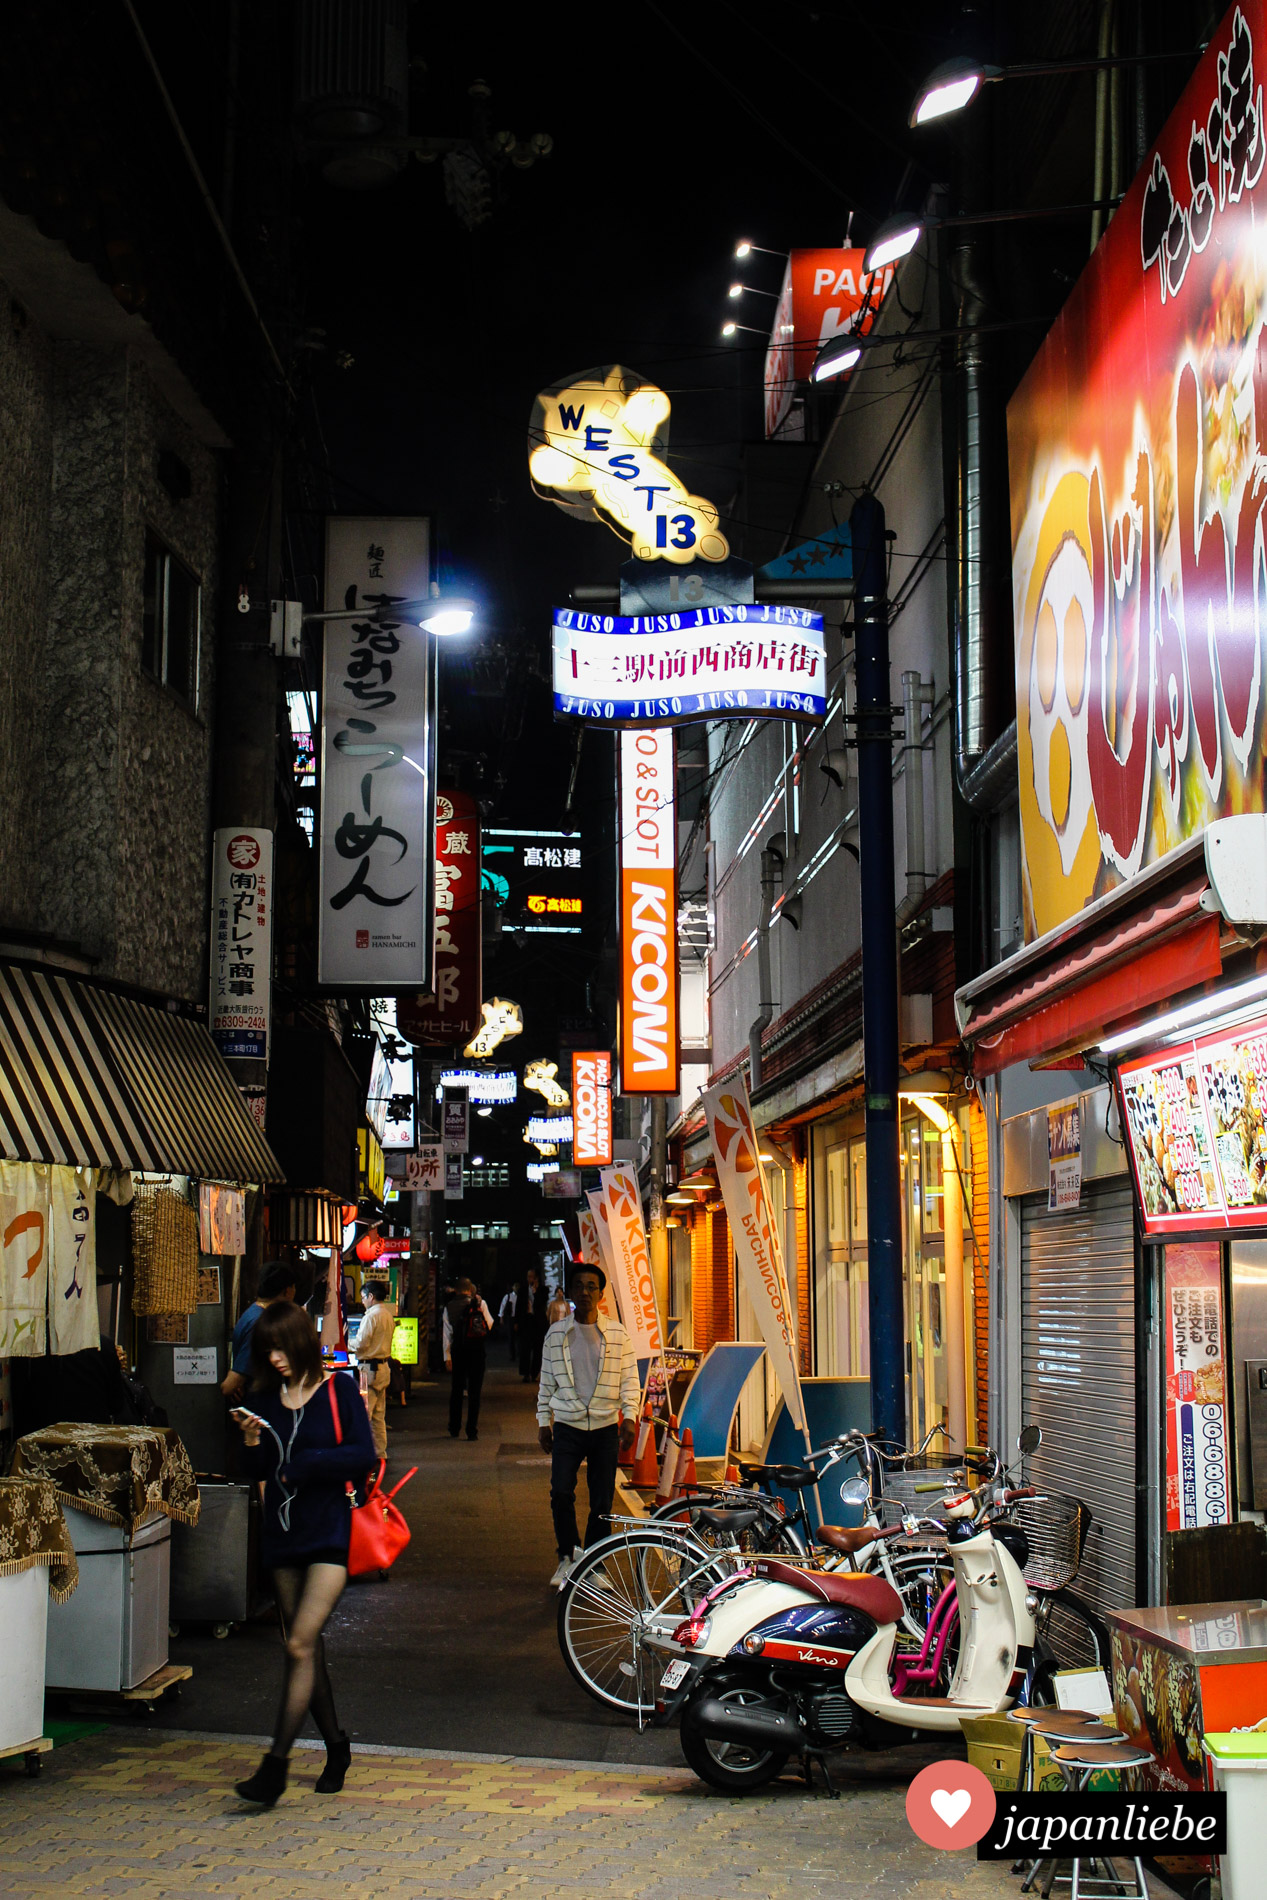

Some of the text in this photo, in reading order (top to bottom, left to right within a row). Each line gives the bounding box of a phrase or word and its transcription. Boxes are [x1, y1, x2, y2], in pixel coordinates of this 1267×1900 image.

[558, 403, 670, 511] WEST
[656, 515, 696, 548] 13
[562, 605, 813, 633] JUSO JUSO JUSO JUSO
[560, 640, 820, 684] 十三駅前西商店街
[562, 690, 814, 719] JUSO JUSO JUSO JUSO
[635, 786, 660, 860] SLOT
[230, 839, 258, 865] 家
[630, 882, 668, 1073] KICONA
[222, 1016, 266, 1028] 6309-2424
[576, 1059, 597, 1159] KICONA
[1176, 1141, 1196, 1169] 500
[1183, 1176, 1202, 1204] 600
[1188, 1290, 1203, 1344] ご注文も
[1203, 1290, 1219, 1357] お電話での
